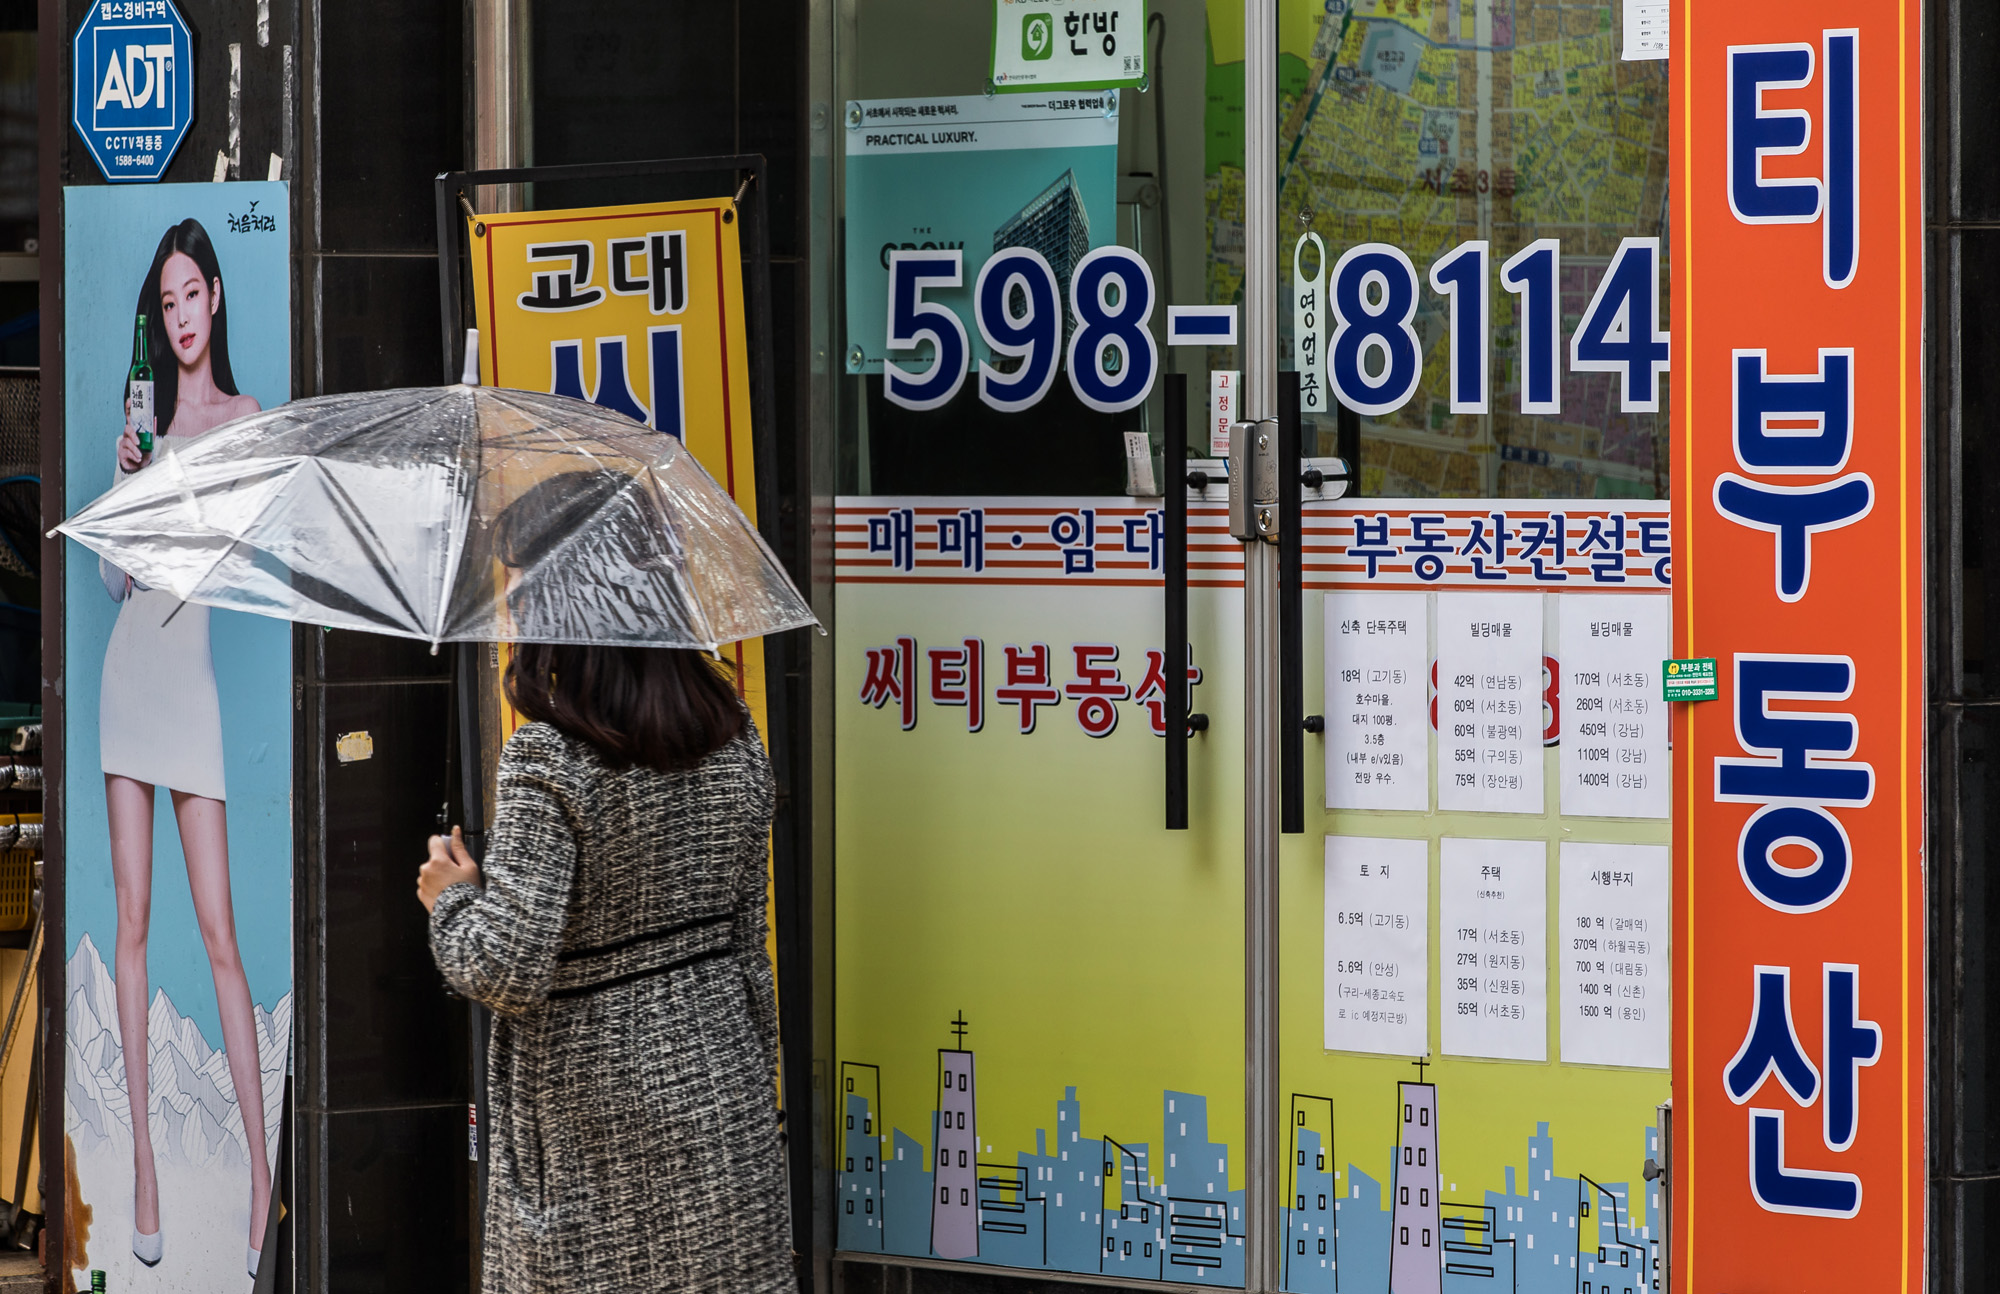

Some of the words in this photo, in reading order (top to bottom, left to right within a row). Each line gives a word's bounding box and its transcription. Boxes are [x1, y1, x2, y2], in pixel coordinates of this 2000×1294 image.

[101, 1, 166, 20] 캡스경비구역
[1064, 10, 1119, 56] 한방
[96, 44, 173, 110] ADT
[105, 135, 163, 151] CCTV작동중
[866, 133, 929, 146] PRACTICAL
[932, 131, 978, 143] LUXURY.
[114, 155, 154, 166] 1588-6400
[227, 212, 276, 234] 처음처럼
[517, 230, 688, 315] 교대
[1300, 288, 1319, 407] 영업중
[1218, 375, 1229, 433] 고정문
[1341, 620, 1360, 634] 신축
[1367, 620, 1406, 635] 단독주택
[1471, 622, 1512, 638] 빌딩매물
[1591, 622, 1633, 637] 빌딩매물
[1341, 669, 1360, 683] 18억
[1454, 674, 1474, 688] 42억
[1574, 672, 1600, 686] 170억
[1454, 699, 1474, 713] 60억
[1576, 697, 1603, 712] 260억
[1352, 714, 1368, 725] 대지
[1455, 723, 1474, 738] 60억
[1580, 722, 1606, 737] 450억
[1365, 734, 1384, 746] 3.5층
[1455, 748, 1475, 763] 55억
[1578, 747, 1609, 762] 1100억
[1355, 772, 1371, 784] 전망
[1455, 773, 1475, 787] 75억
[1578, 773, 1609, 787] 1400억
[1481, 866, 1500, 881] 주택
[1591, 870, 1633, 887] 시행부지
[1338, 912, 1363, 926] 6.5억
[1576, 917, 1591, 928] 180
[1596, 917, 1604, 930] 억
[1457, 928, 1477, 942] 17억
[1573, 938, 1597, 951] 370억
[1338, 960, 1363, 975] 5.6억
[1457, 953, 1477, 967] 27억
[1576, 961, 1591, 972] 700
[1596, 961, 1604, 974] 억
[1457, 977, 1477, 992] 35억
[1579, 983, 1599, 995] 1400
[1603, 984, 1611, 996] 억
[1338, 1009, 1346, 1018] 로
[1362, 1010, 1407, 1024] 예정지근방)
[1458, 1002, 1477, 1016] 55억
[1579, 1005, 1599, 1017] 1500
[1603, 1006, 1612, 1019] 억
